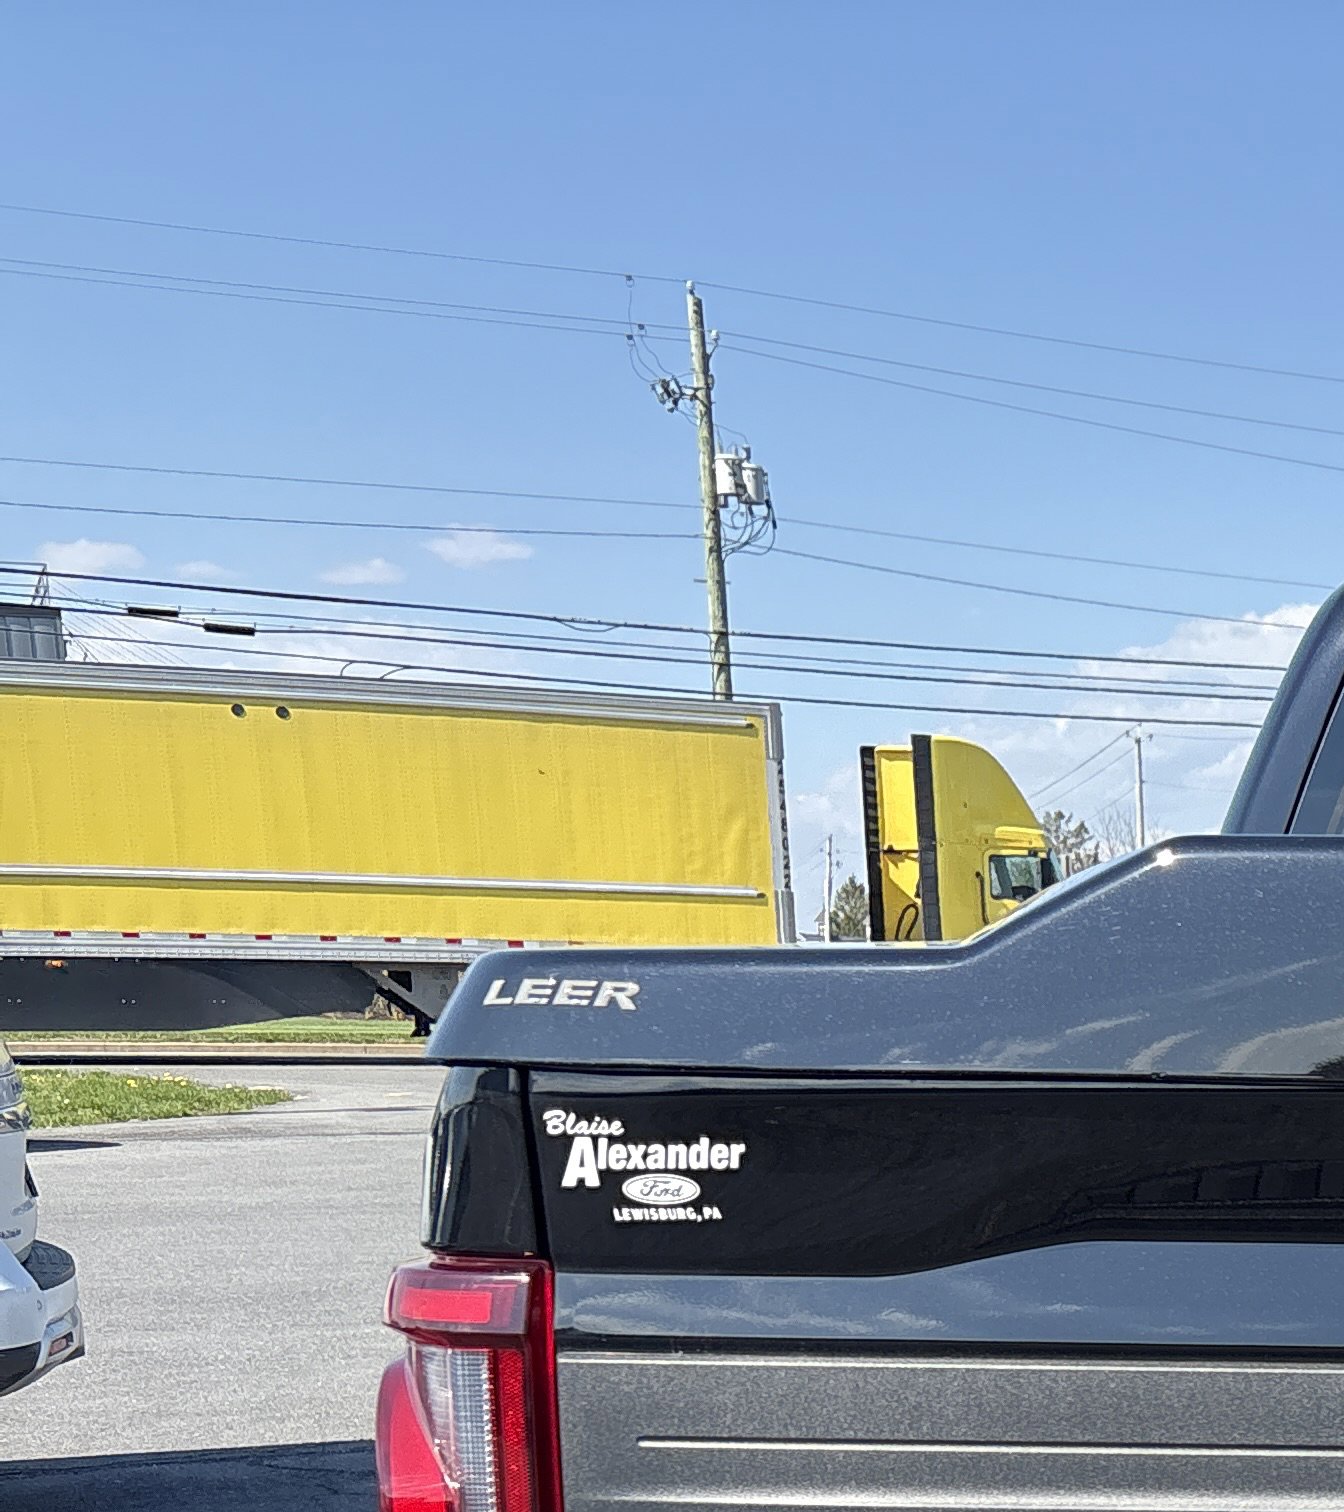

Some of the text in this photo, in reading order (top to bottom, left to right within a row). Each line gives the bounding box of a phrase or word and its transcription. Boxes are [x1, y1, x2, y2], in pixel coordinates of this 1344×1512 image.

[482, 977, 641, 1011] LEER
[543, 1109, 625, 1136] Blaise
[561, 1135, 746, 1188] Alexander
[640, 1179, 684, 1198] Ford
